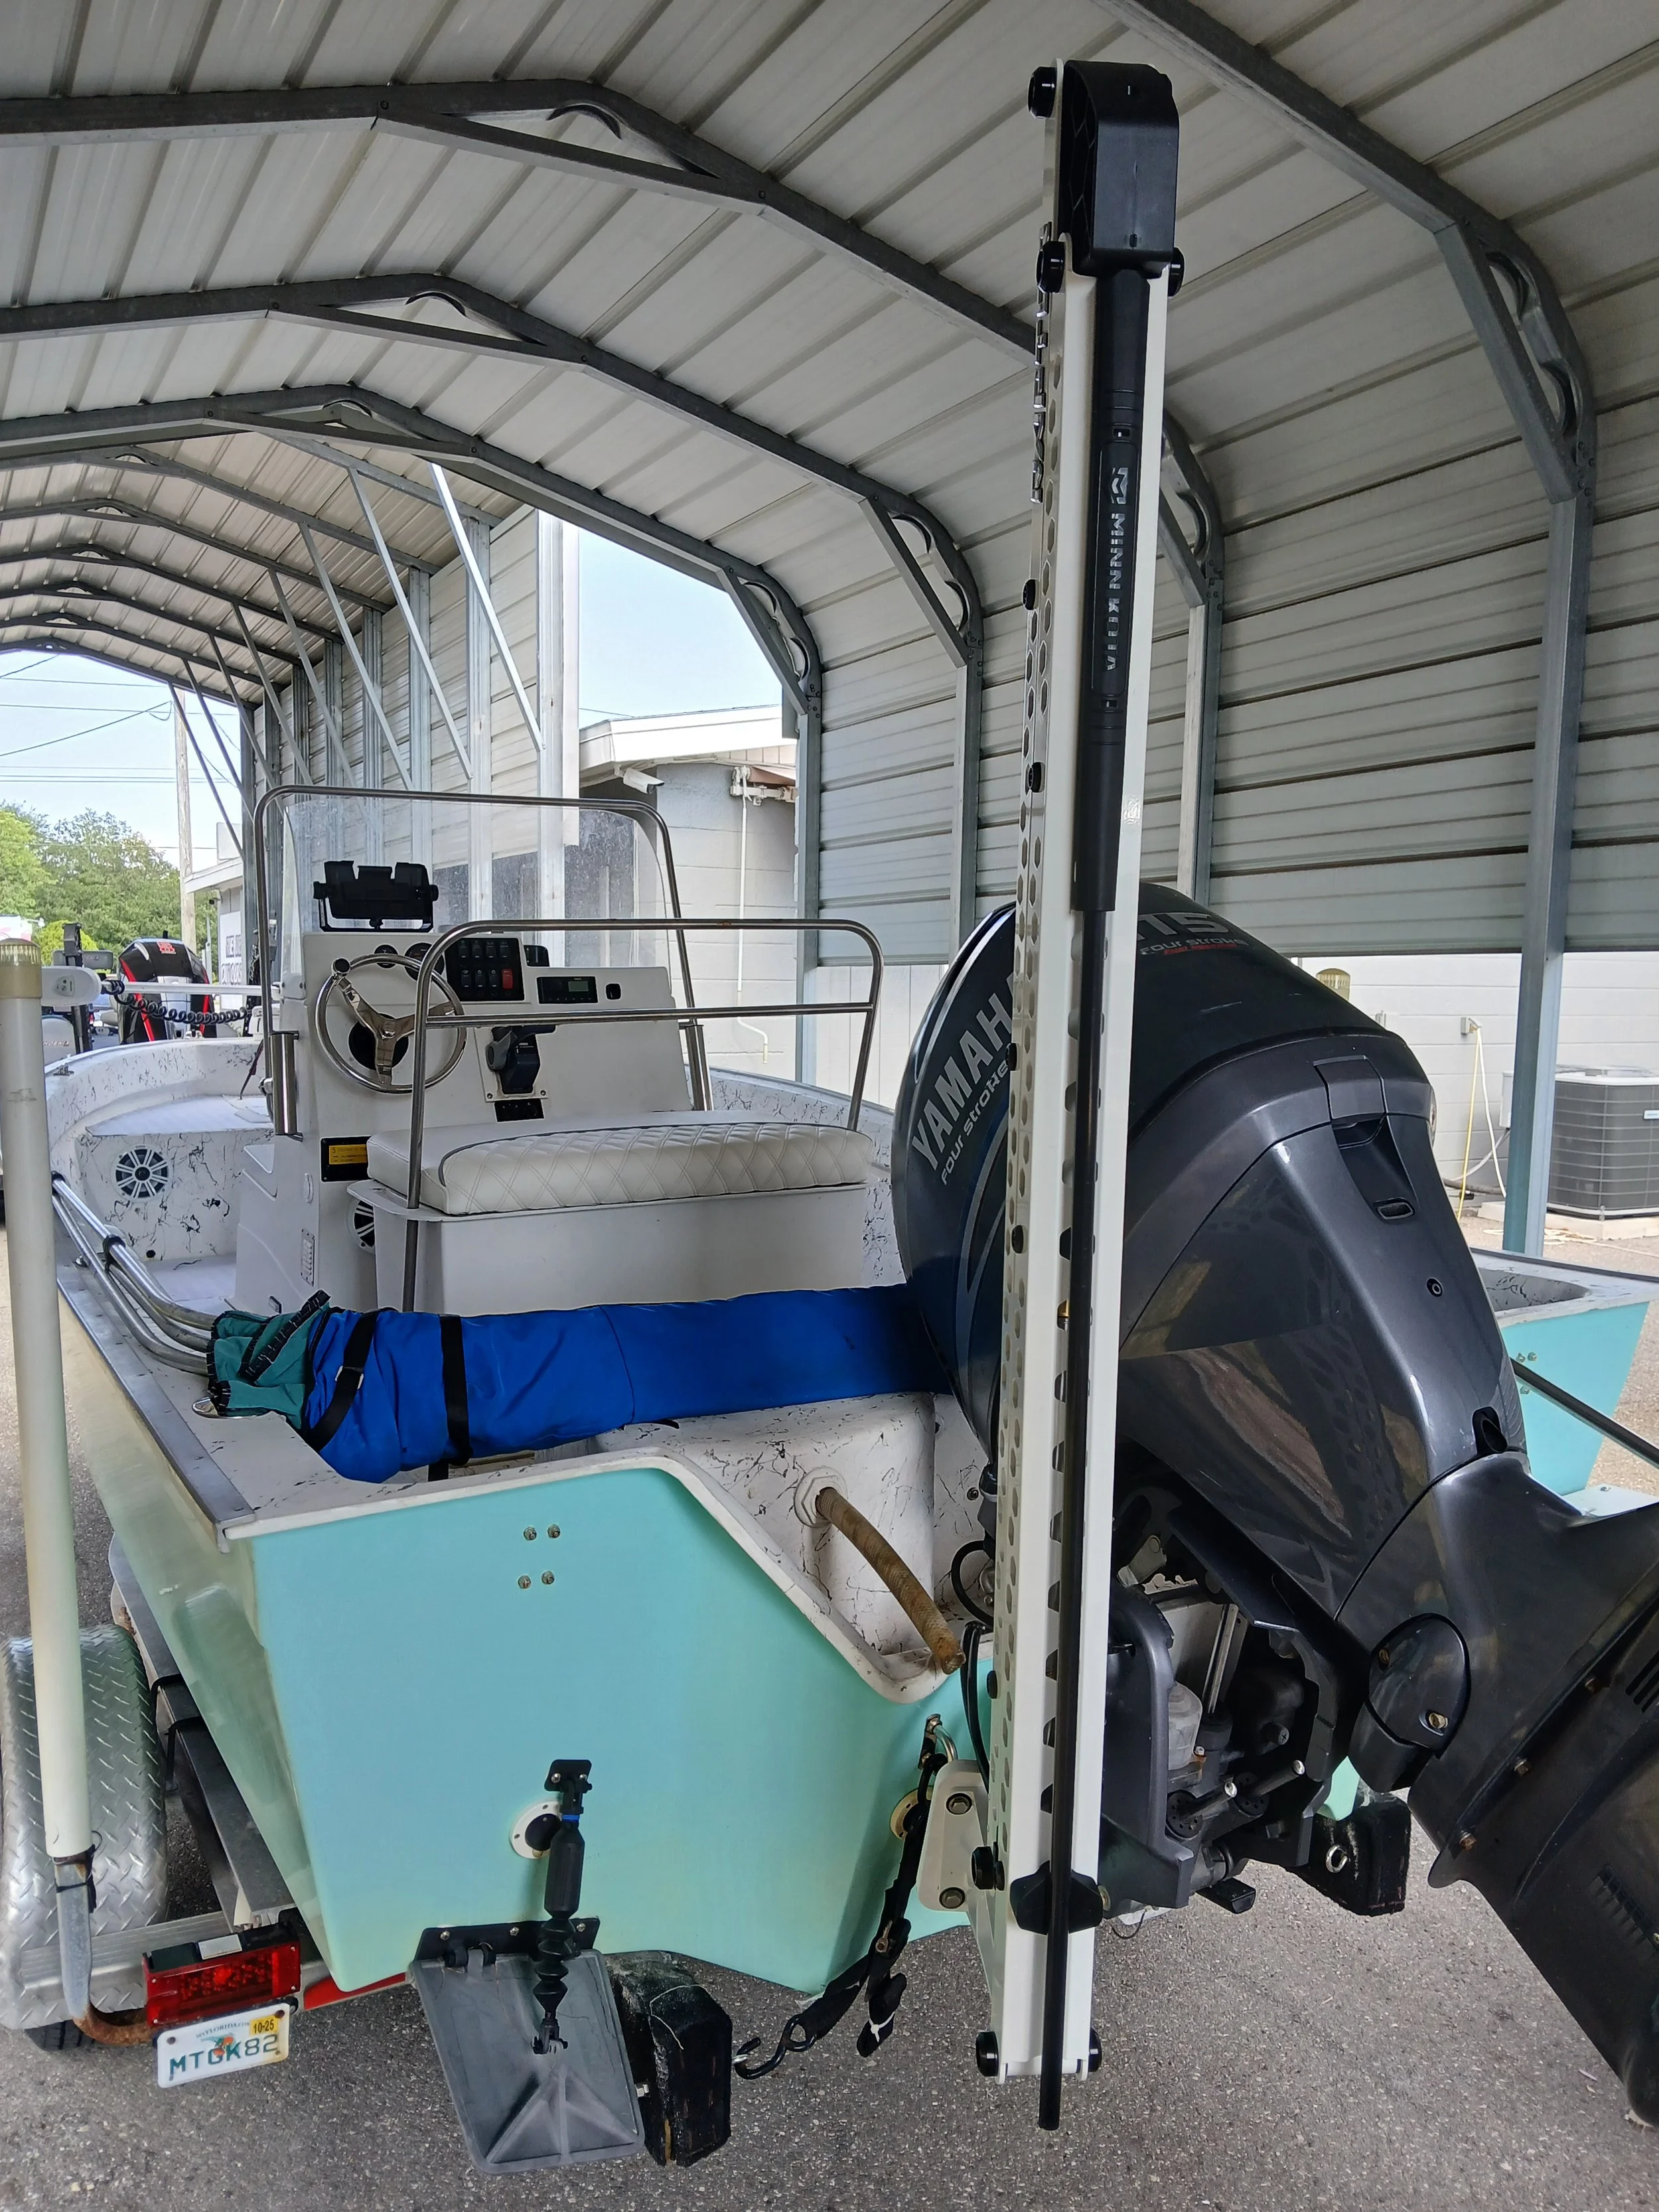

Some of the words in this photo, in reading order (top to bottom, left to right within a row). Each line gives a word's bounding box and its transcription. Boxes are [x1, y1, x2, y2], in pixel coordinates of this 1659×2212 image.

[1110, 513, 1125, 589] MINN
[1107, 598, 1119, 670] KOTA
[1137, 913, 1229, 940] 15
[253, 2020, 275, 2033] 10-25
